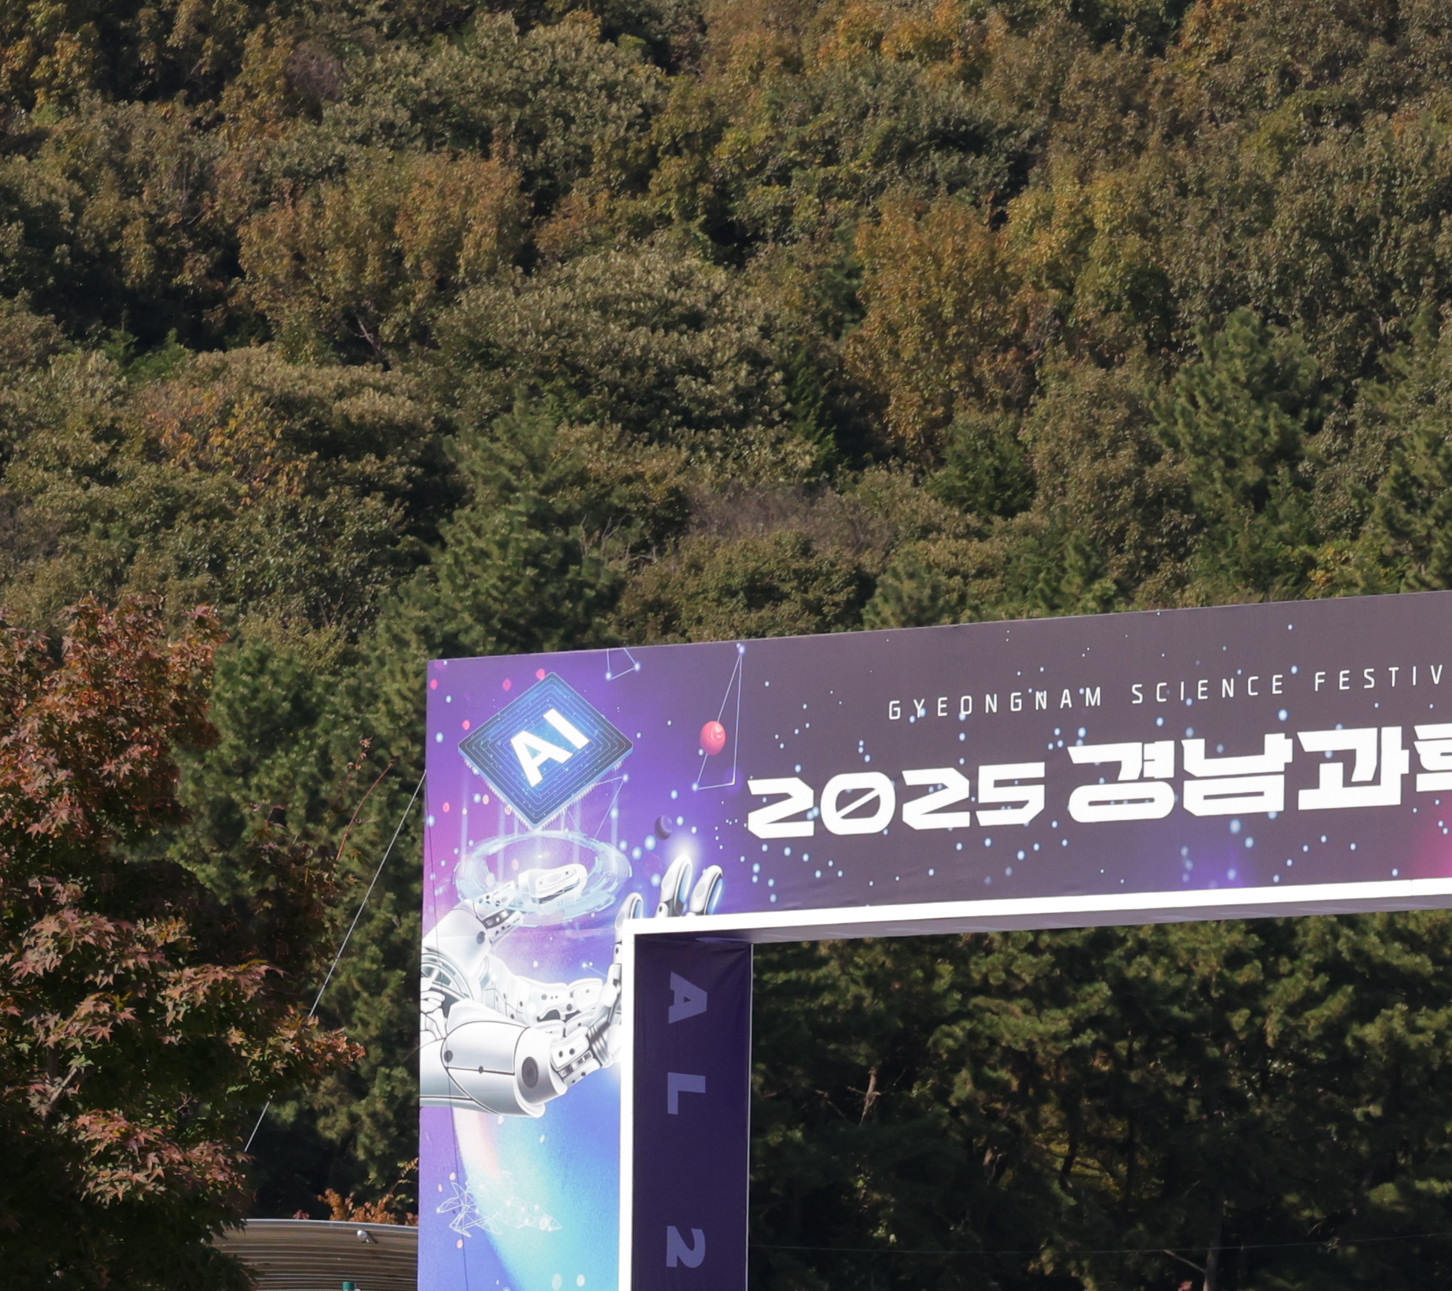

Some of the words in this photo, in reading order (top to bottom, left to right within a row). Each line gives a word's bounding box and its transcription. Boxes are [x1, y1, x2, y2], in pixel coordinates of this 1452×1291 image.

[888, 686, 1101, 720] GYEONGNAM
[1131, 674, 1284, 704] SCIENCE
[510, 708, 590, 788] AI
[747, 761, 1045, 839] 2025
